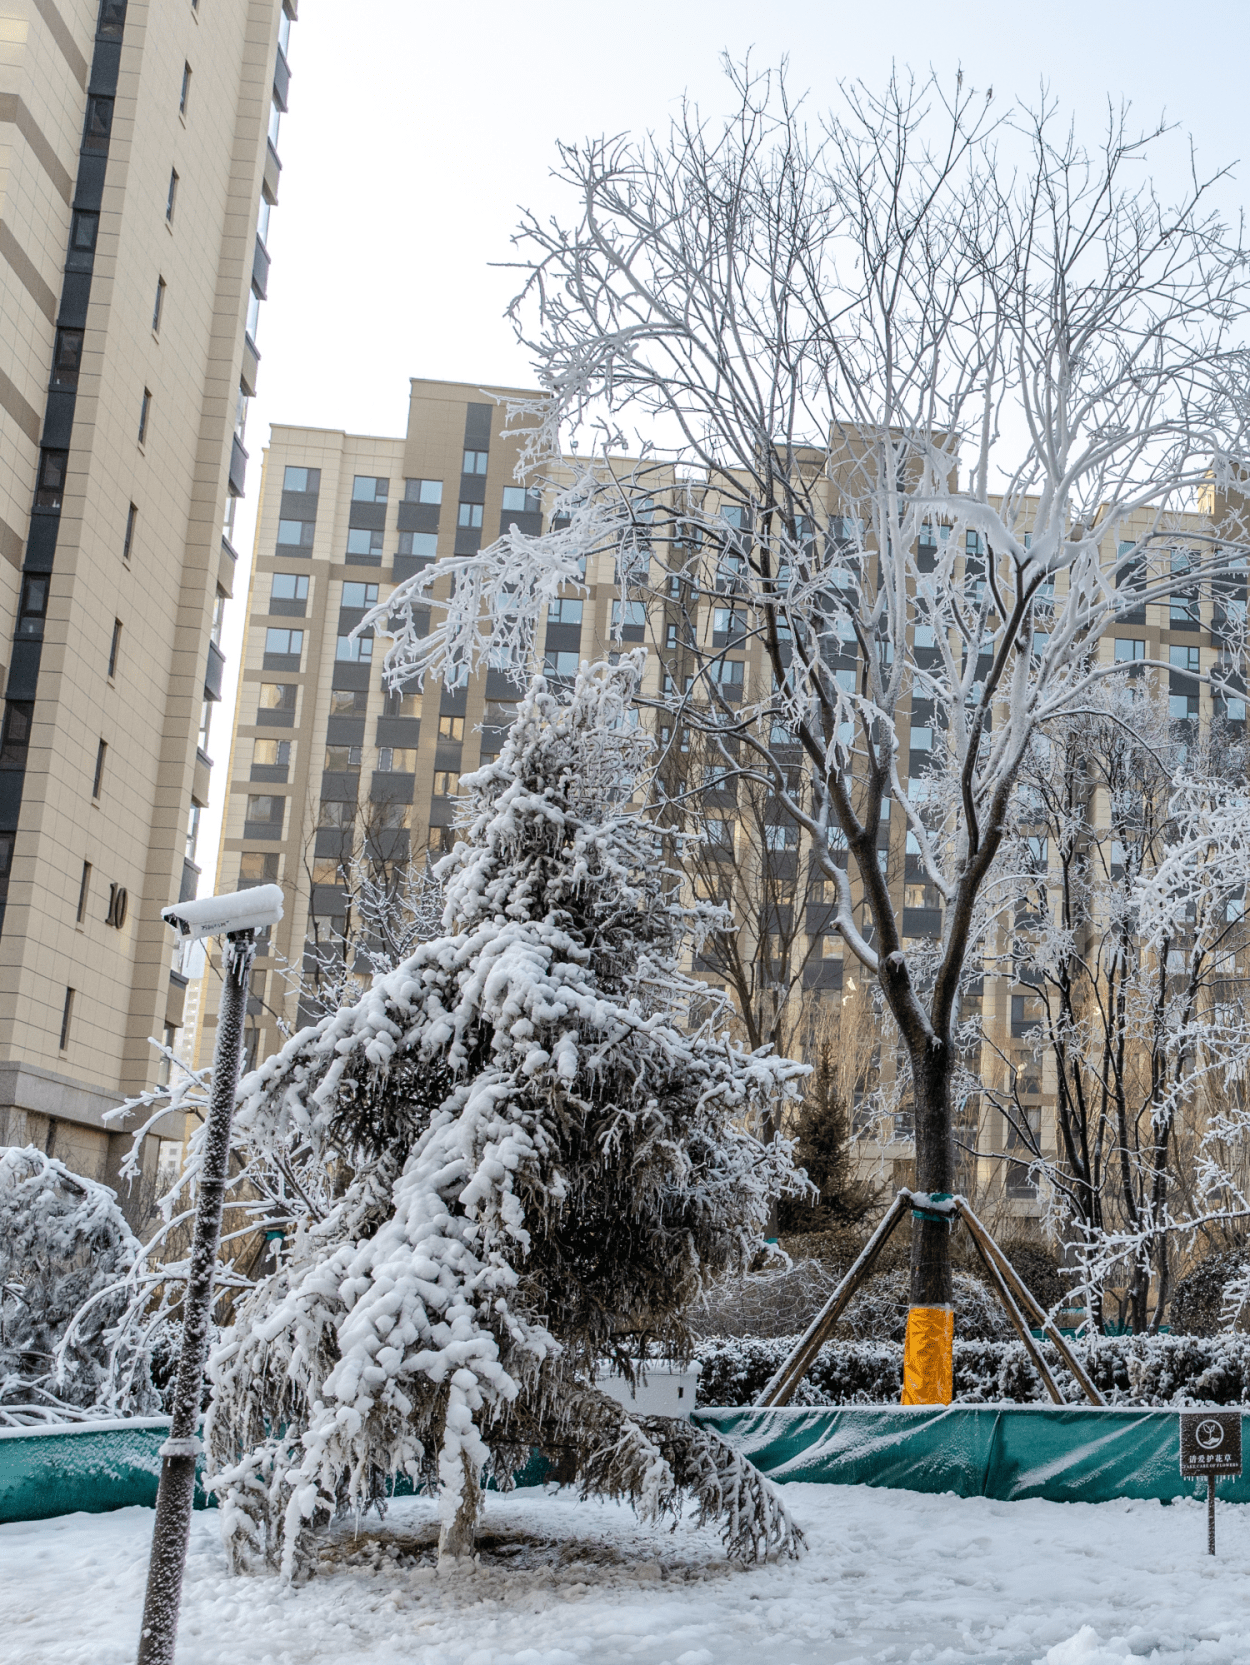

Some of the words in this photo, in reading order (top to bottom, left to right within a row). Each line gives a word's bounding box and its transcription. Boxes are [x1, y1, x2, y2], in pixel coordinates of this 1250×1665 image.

[105, 882, 128, 929] 10
[1189, 1454, 1232, 1463] 请爱护花草
